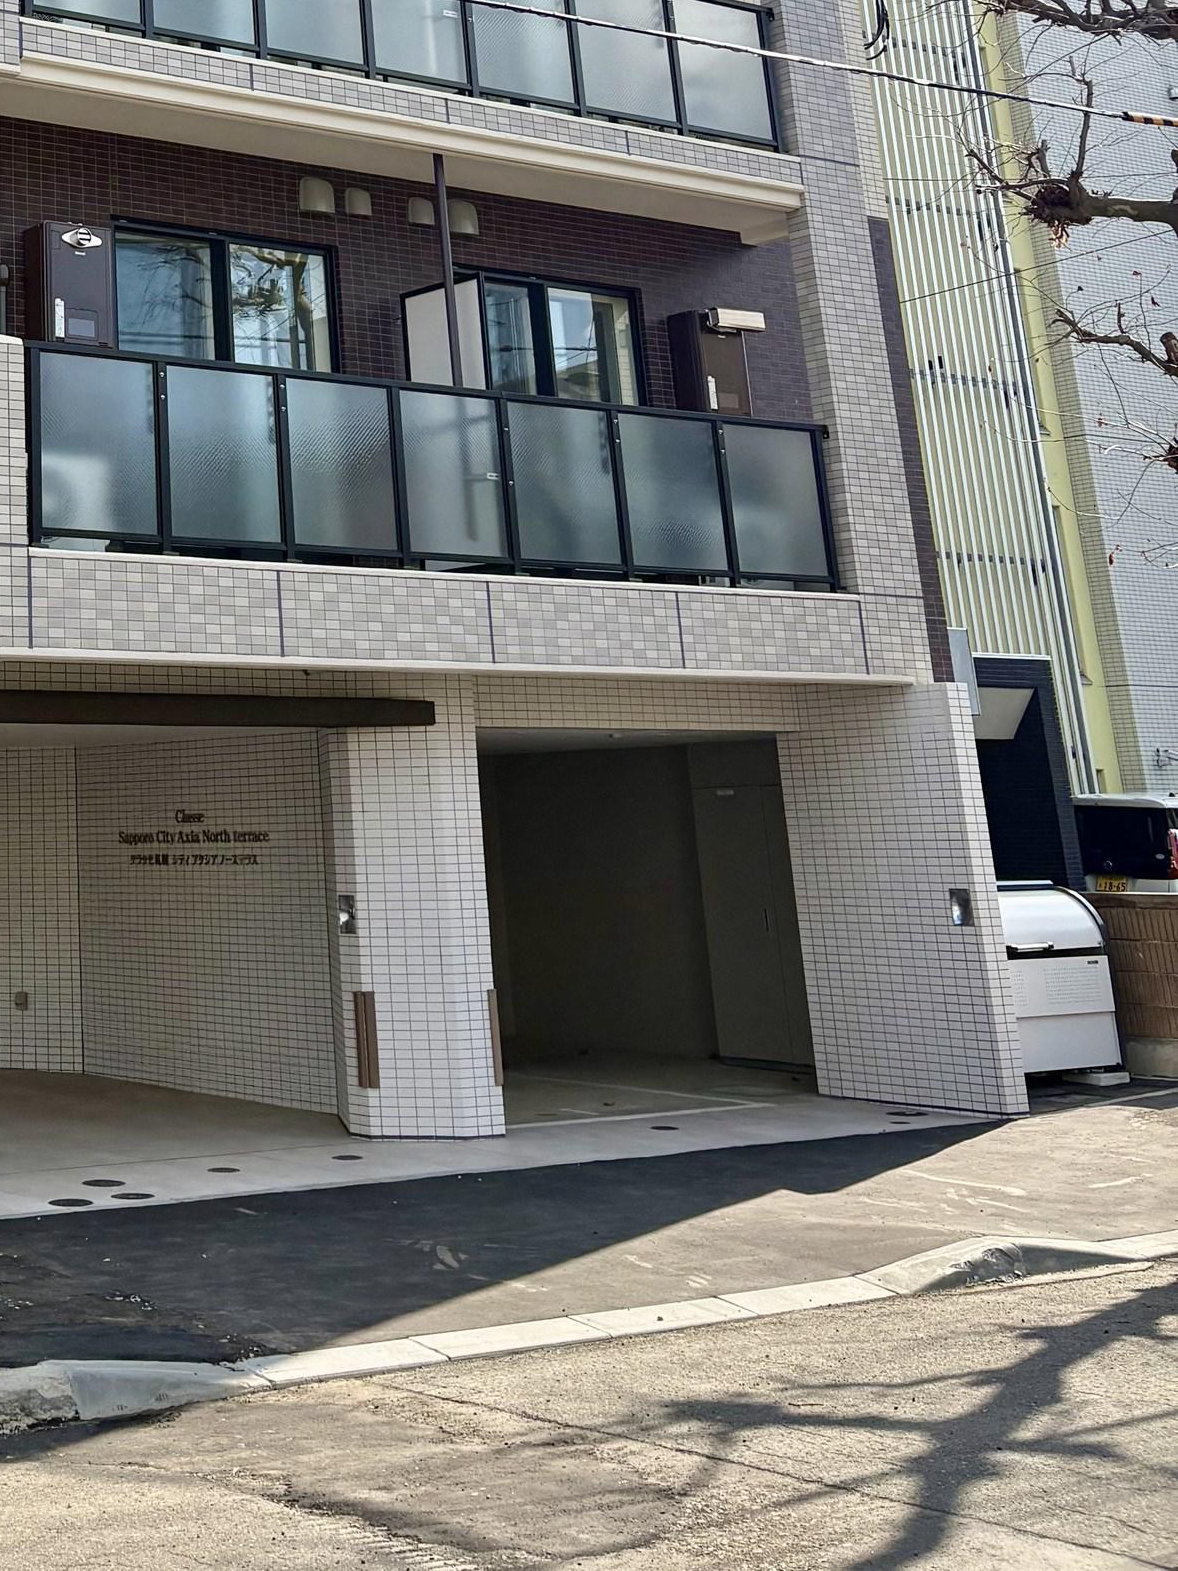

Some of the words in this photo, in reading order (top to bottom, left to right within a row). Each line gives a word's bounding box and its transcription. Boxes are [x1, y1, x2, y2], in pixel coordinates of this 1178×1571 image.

[118, 831, 155, 846] Sapporo
[156, 830, 175, 845] City
[202, 829, 231, 843] North
